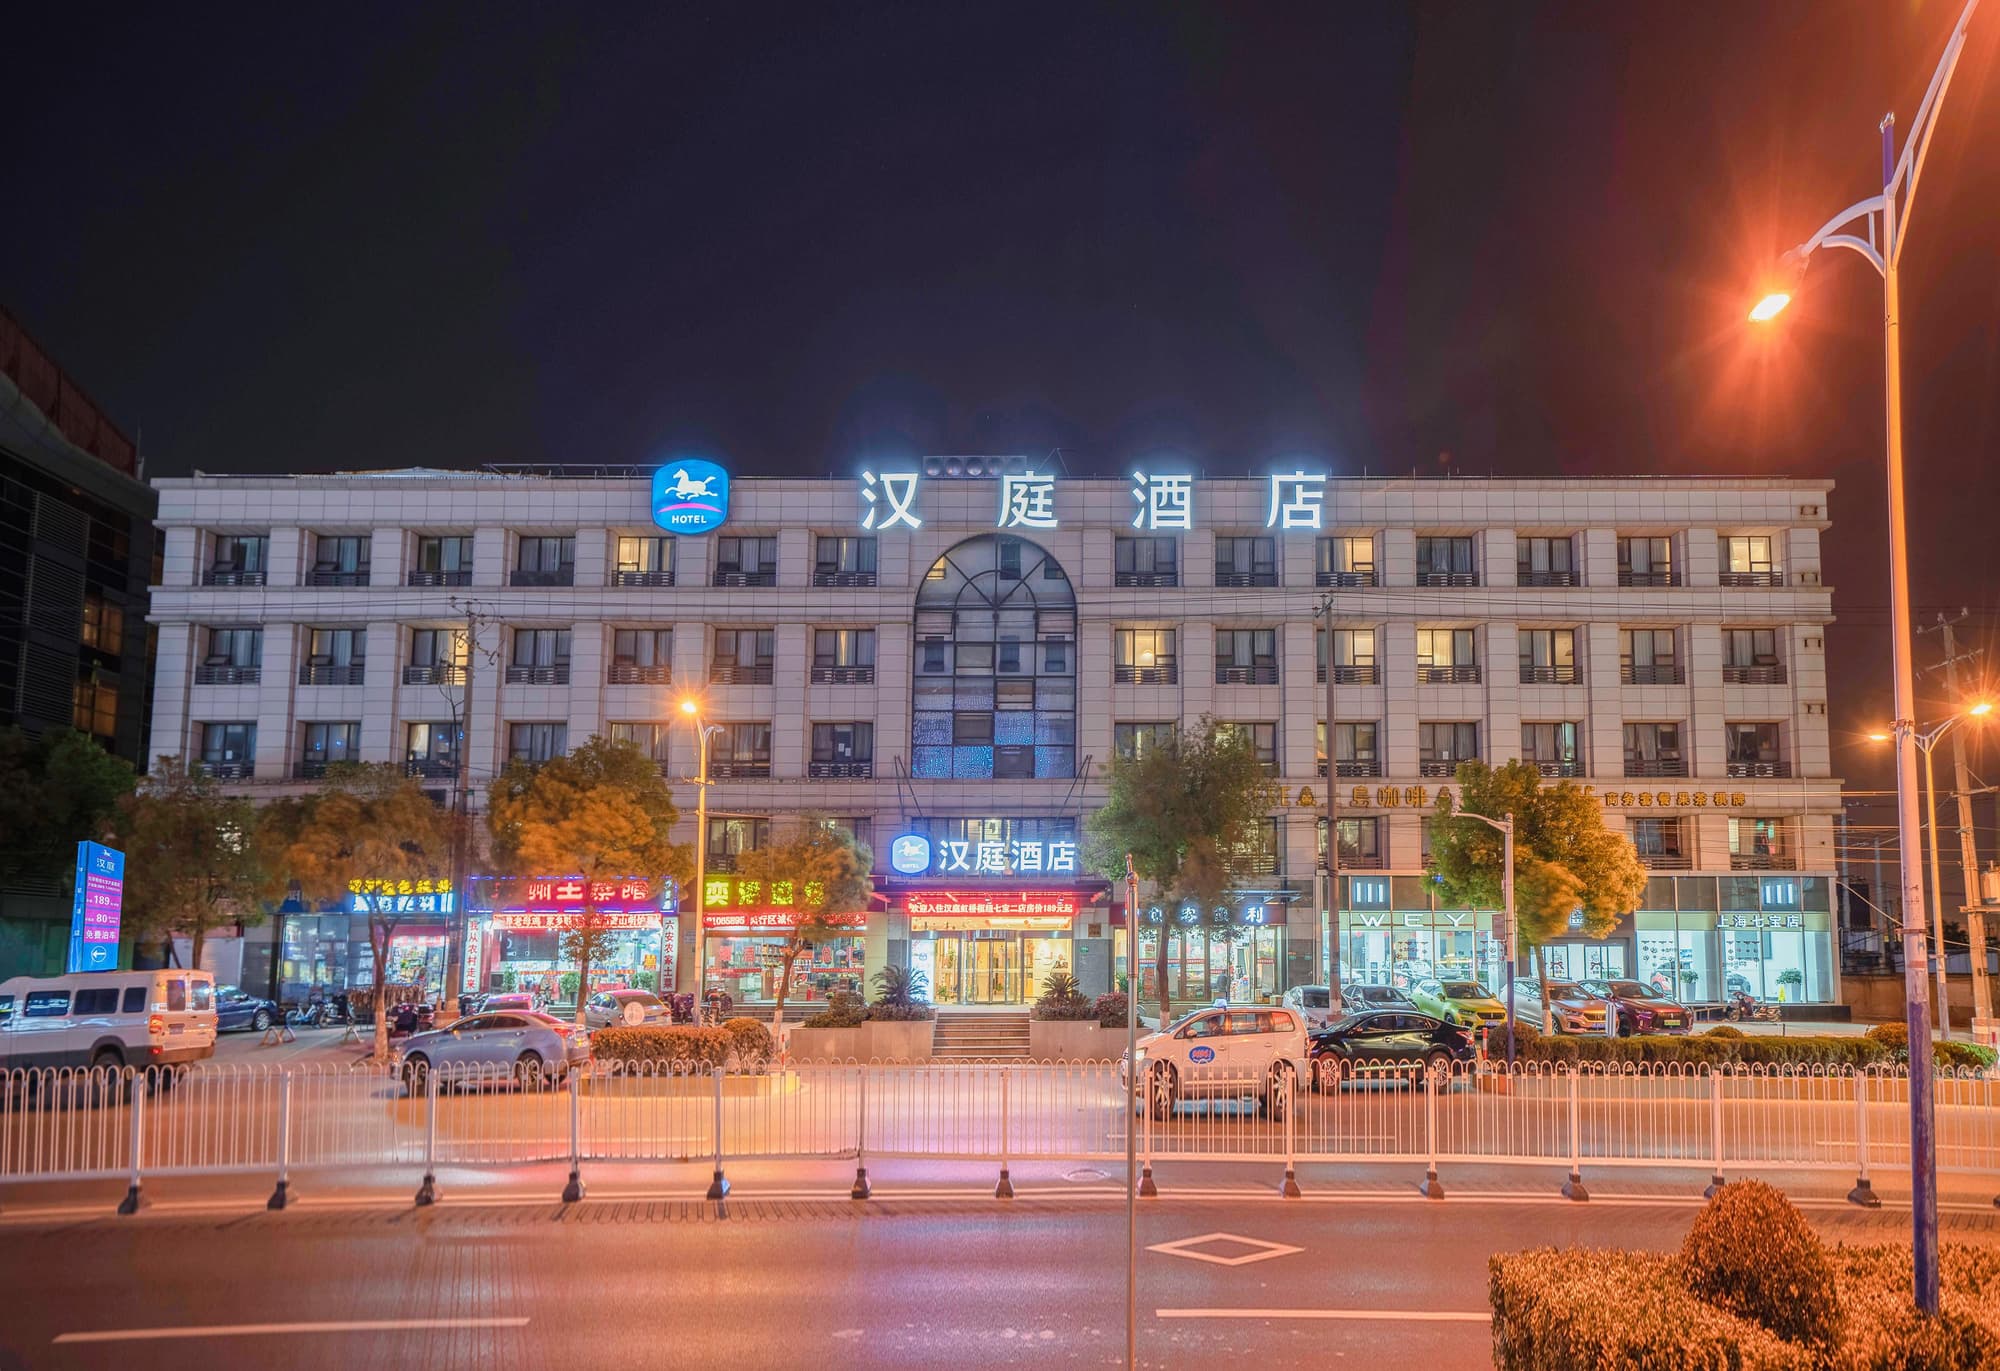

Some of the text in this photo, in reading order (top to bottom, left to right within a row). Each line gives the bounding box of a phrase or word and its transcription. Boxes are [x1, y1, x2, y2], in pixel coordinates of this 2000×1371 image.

[861, 470, 1326, 530] 汉庭酒店
[671, 514, 708, 524] HOTEL
[938, 839, 1076, 872] 汉庭酒店
[96, 857, 115, 872] 汉庭
[94, 895, 110, 906] 189
[96, 913, 108, 923] 80
[1360, 913, 1467, 927] WEY
[1716, 914, 1801, 928] 上海七宝店
[85, 930, 116, 940] 免费泊车
